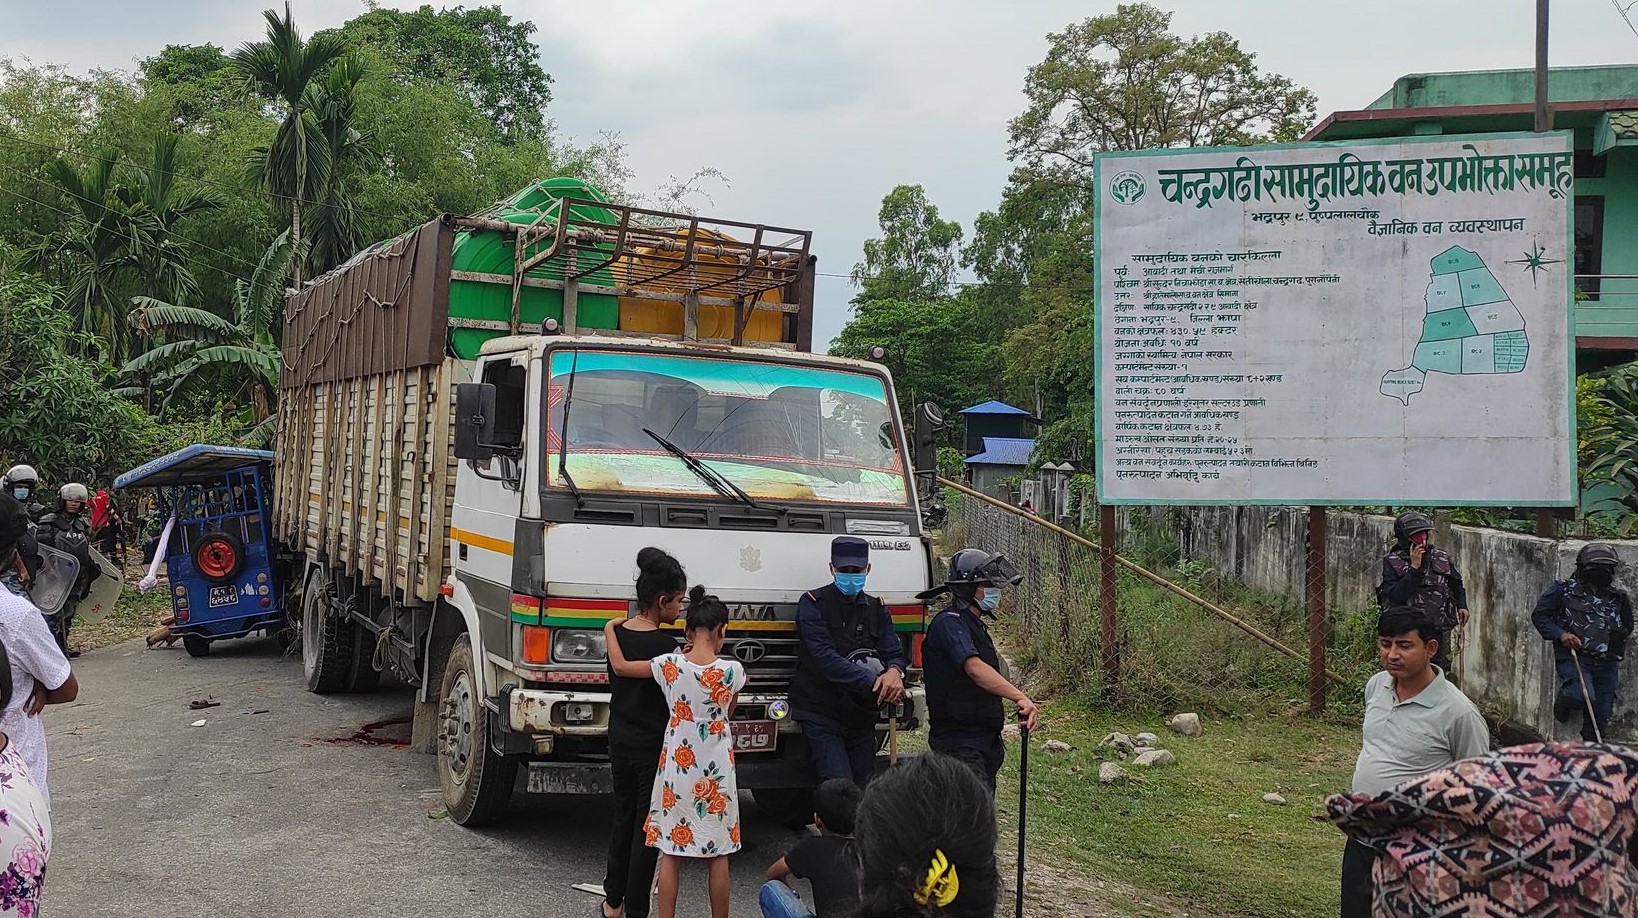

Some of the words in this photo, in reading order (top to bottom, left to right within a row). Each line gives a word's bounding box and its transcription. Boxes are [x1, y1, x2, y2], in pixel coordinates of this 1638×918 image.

[1158, 156, 1262, 208] चन्द्रगढी
[1263, 153, 1386, 211] सामुदायिक
[1385, 158, 1426, 197] वन
[1423, 144, 1517, 196] उपभोक्ता
[1515, 151, 1574, 200] समूह
[1251, 212, 1291, 226] भद्रपुर
[1368, 218, 1418, 238] वैज्ञानिक
[1422, 221, 1443, 234] वन
[1448, 217, 1527, 234] व्यवस्थापन
[1131, 251, 1188, 265] सामुदायिक
[1191, 250, 1223, 262] वनको
[725, 603, 776, 620] TATA
